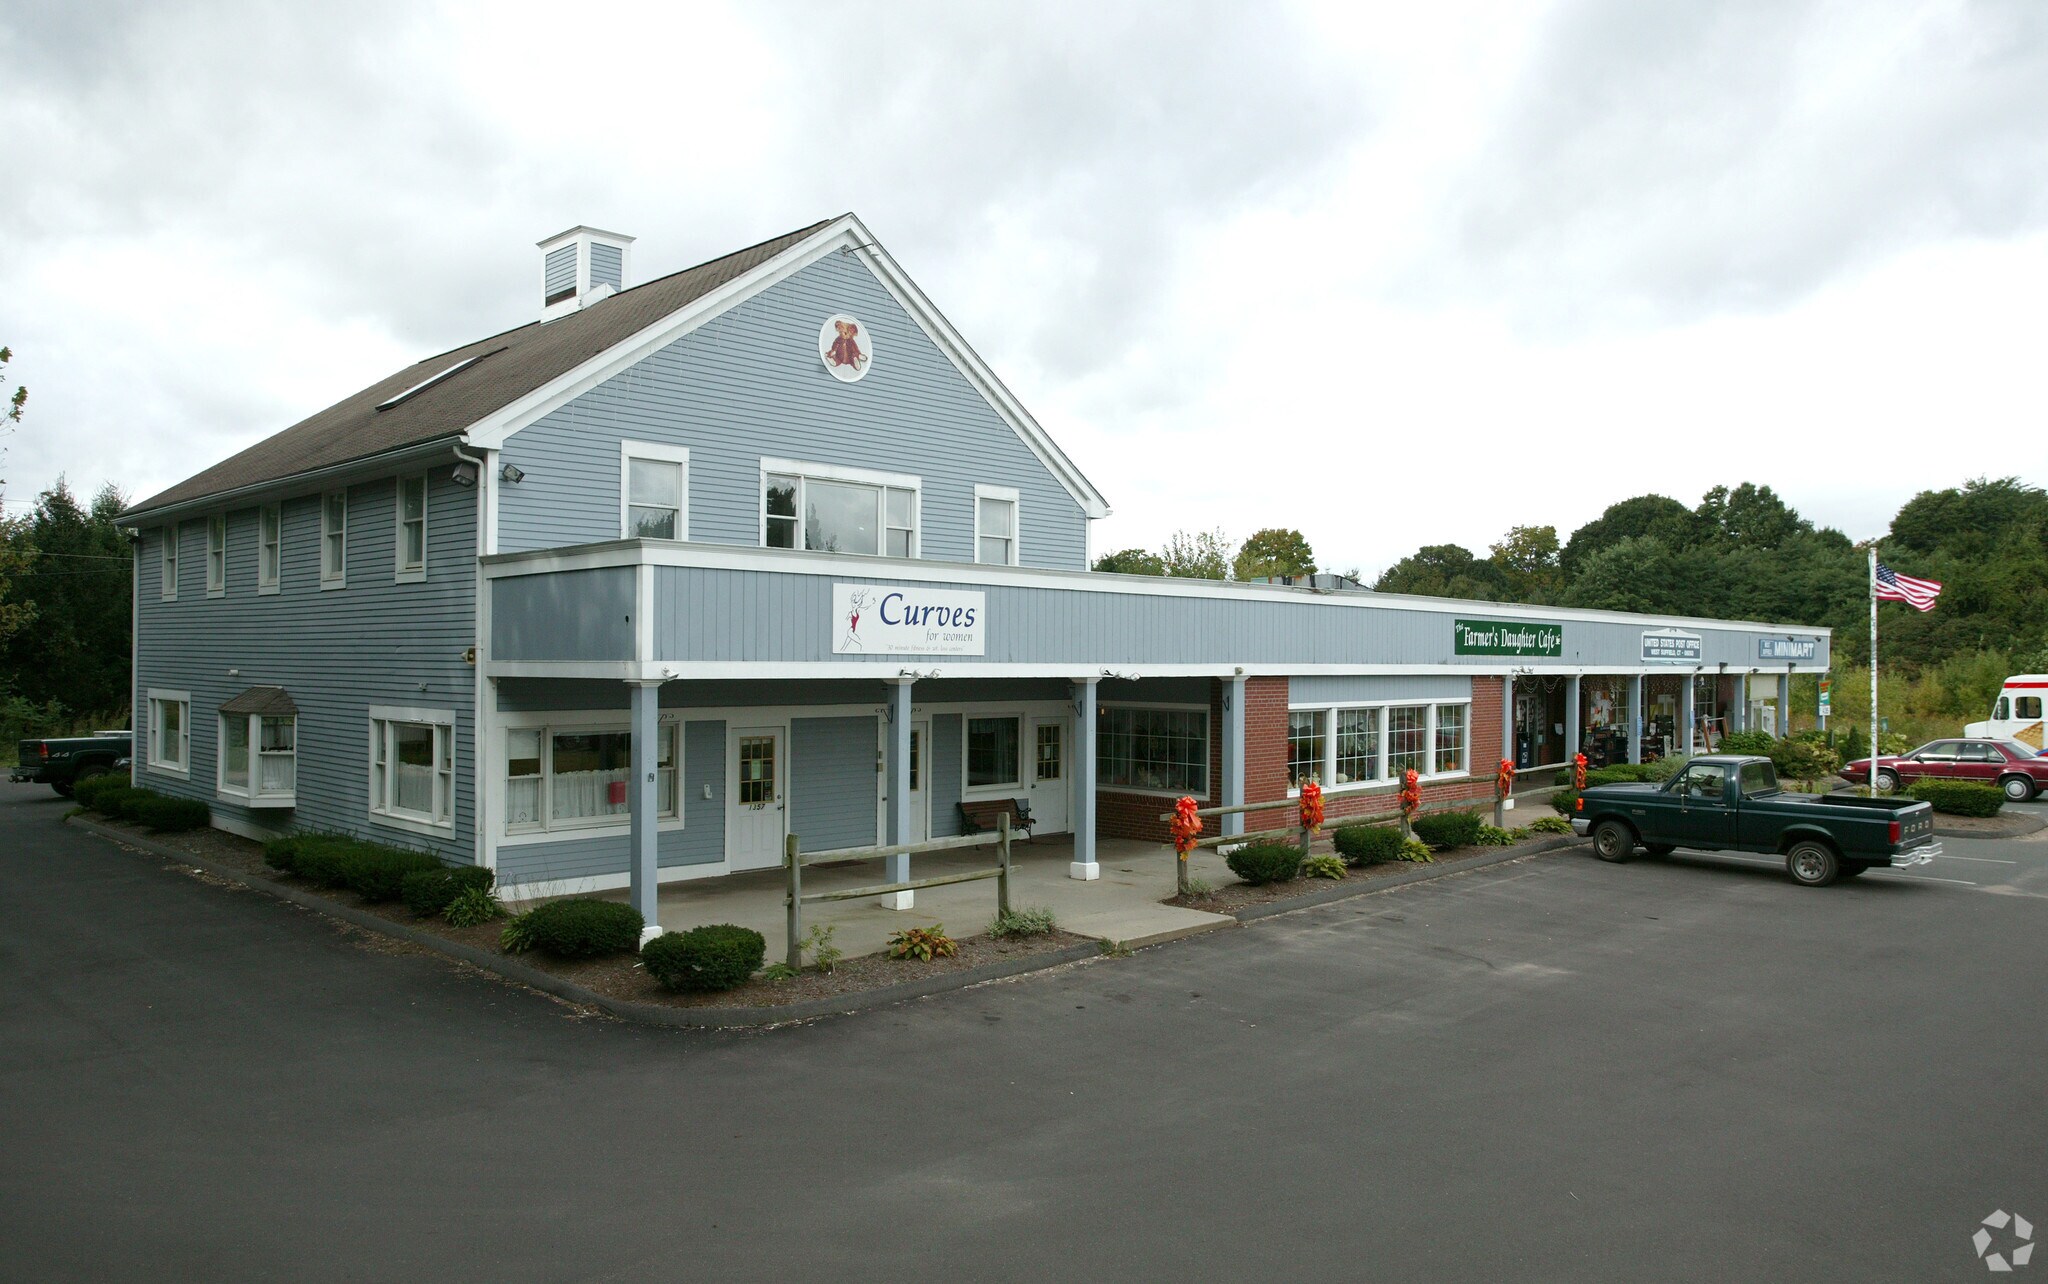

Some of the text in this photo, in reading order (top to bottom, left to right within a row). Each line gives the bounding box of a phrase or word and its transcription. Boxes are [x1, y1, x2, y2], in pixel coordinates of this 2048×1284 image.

[880, 592, 976, 627] Curves
[925, 628, 973, 643] for women
[1455, 622, 1555, 654] The Farmer's Daughter Cafe
[1644, 638, 1700, 649] UNITED STATES POST OFFICE
[1774, 641, 1814, 657] MINIMART
[749, 803, 765, 811] 1357
[1904, 820, 1929, 835] FORD
